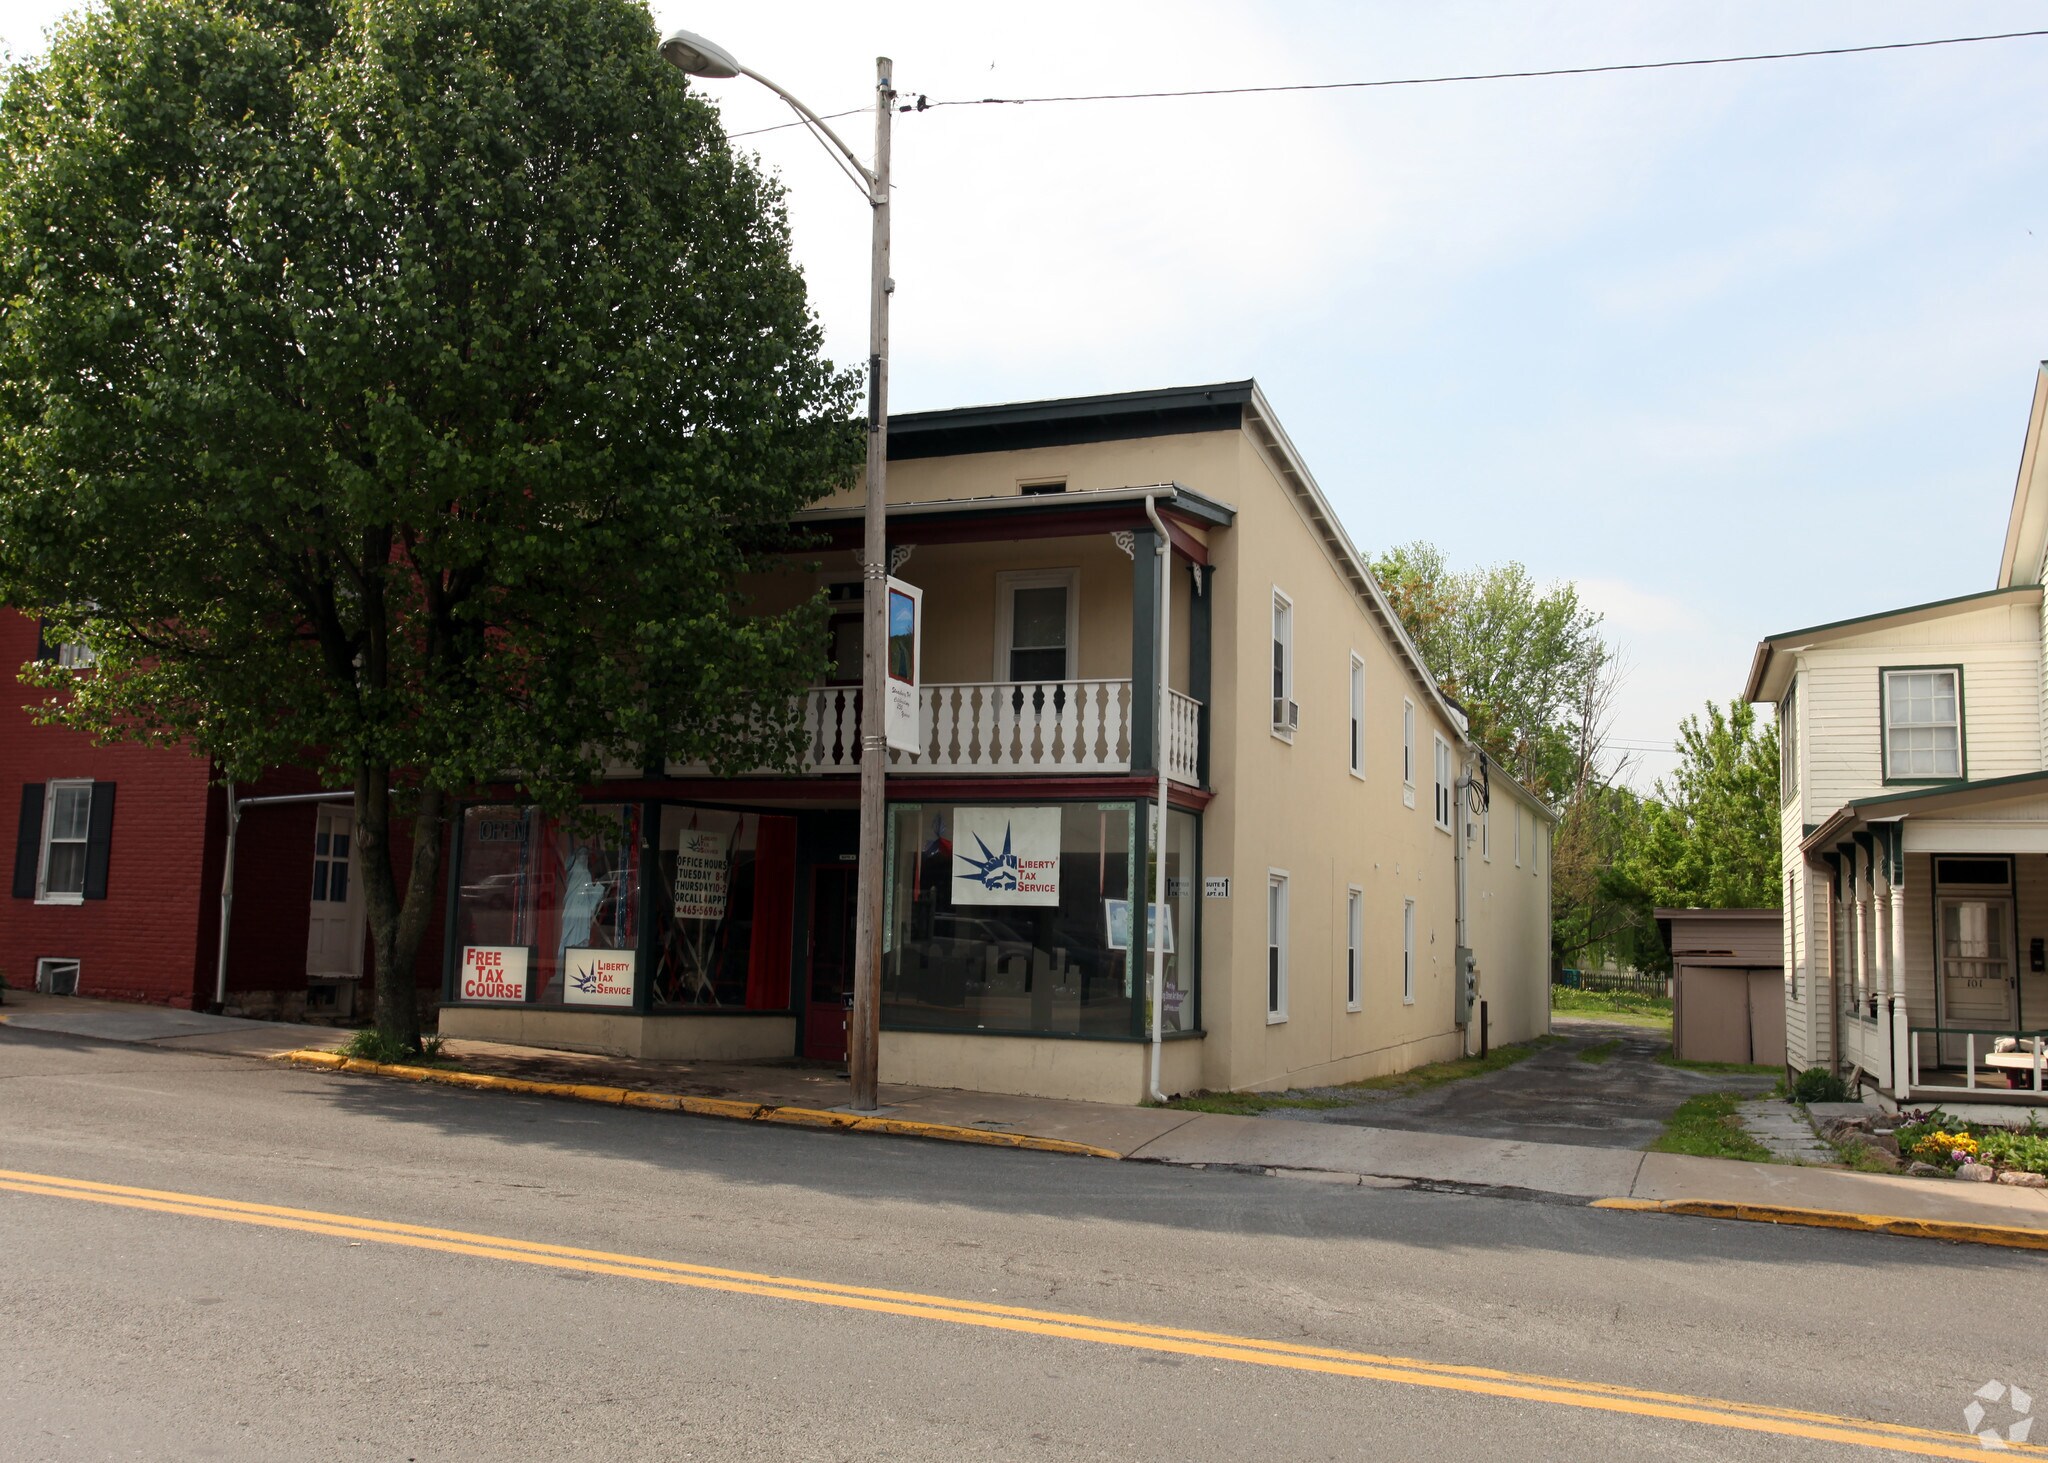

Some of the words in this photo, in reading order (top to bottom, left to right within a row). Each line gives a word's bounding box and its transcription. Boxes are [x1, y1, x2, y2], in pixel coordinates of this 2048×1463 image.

[481, 821, 523, 840] OPEN
[677, 856, 702, 868] OFFICE
[704, 859, 727, 870] HOURS
[1018, 858, 1056, 869] LIBERTY
[679, 868, 711, 880] TUESDAY
[1018, 870, 1037, 880] TAX
[1017, 881, 1056, 892] SERVICE
[466, 948, 502, 966] FREE
[597, 960, 630, 971] LIBERTY
[475, 965, 504, 983] TAX
[597, 971, 613, 982] TAX
[465, 979, 522, 998] COURSE
[596, 983, 631, 995] SERVICE
[1967, 979, 1982, 988] 101
